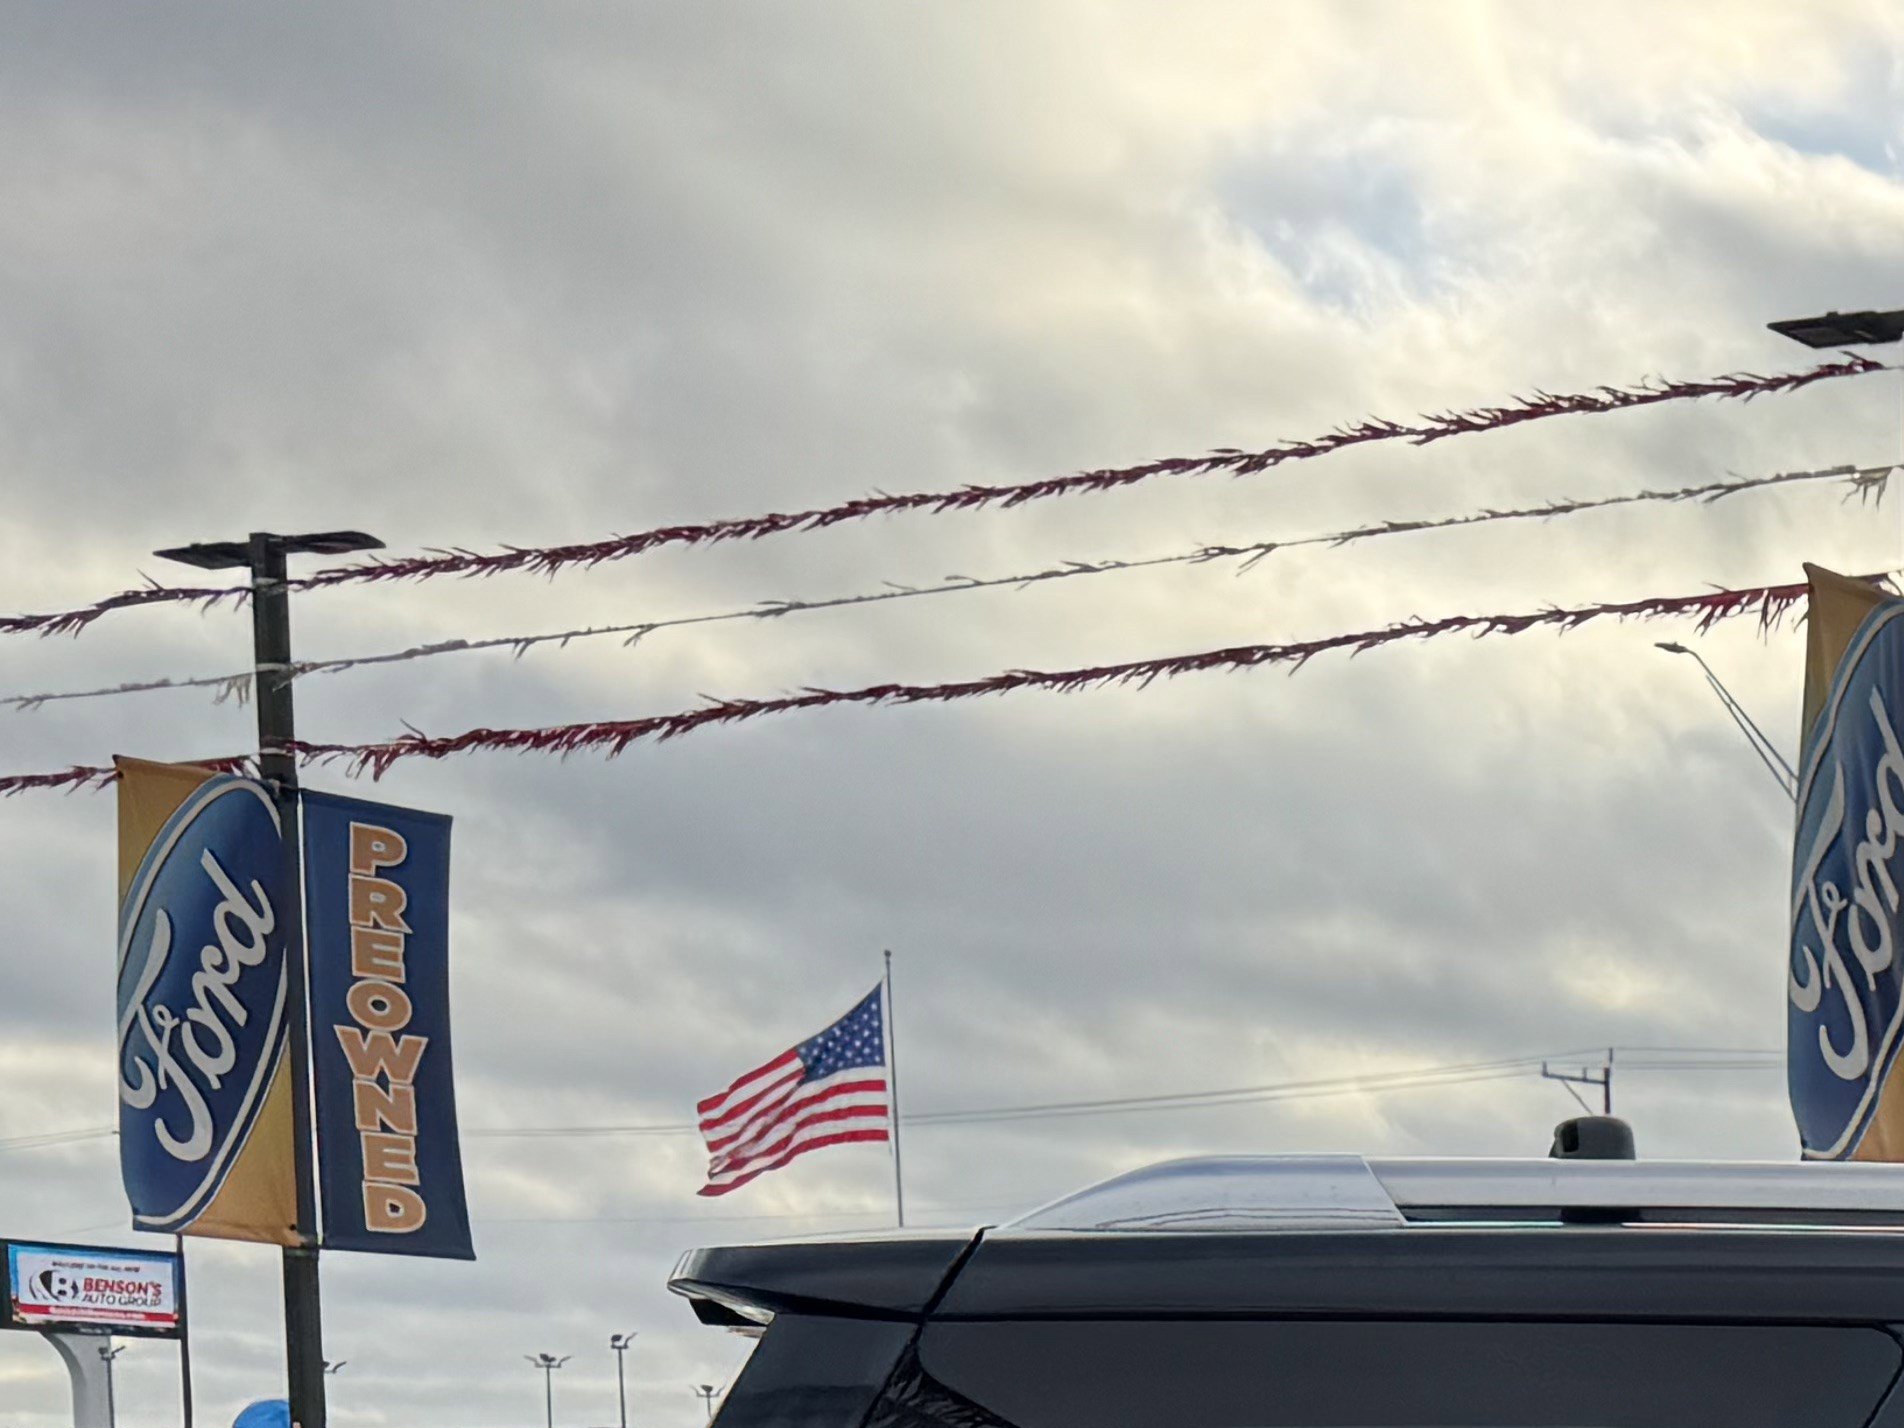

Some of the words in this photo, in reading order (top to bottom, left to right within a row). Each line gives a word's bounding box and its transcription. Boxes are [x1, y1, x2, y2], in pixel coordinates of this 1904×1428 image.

[119, 846, 276, 1163] Ford
[332, 821, 429, 1233] PREOWNED
[82, 1276, 162, 1298] BENSON'S
[82, 1292, 118, 1306] AUTO
